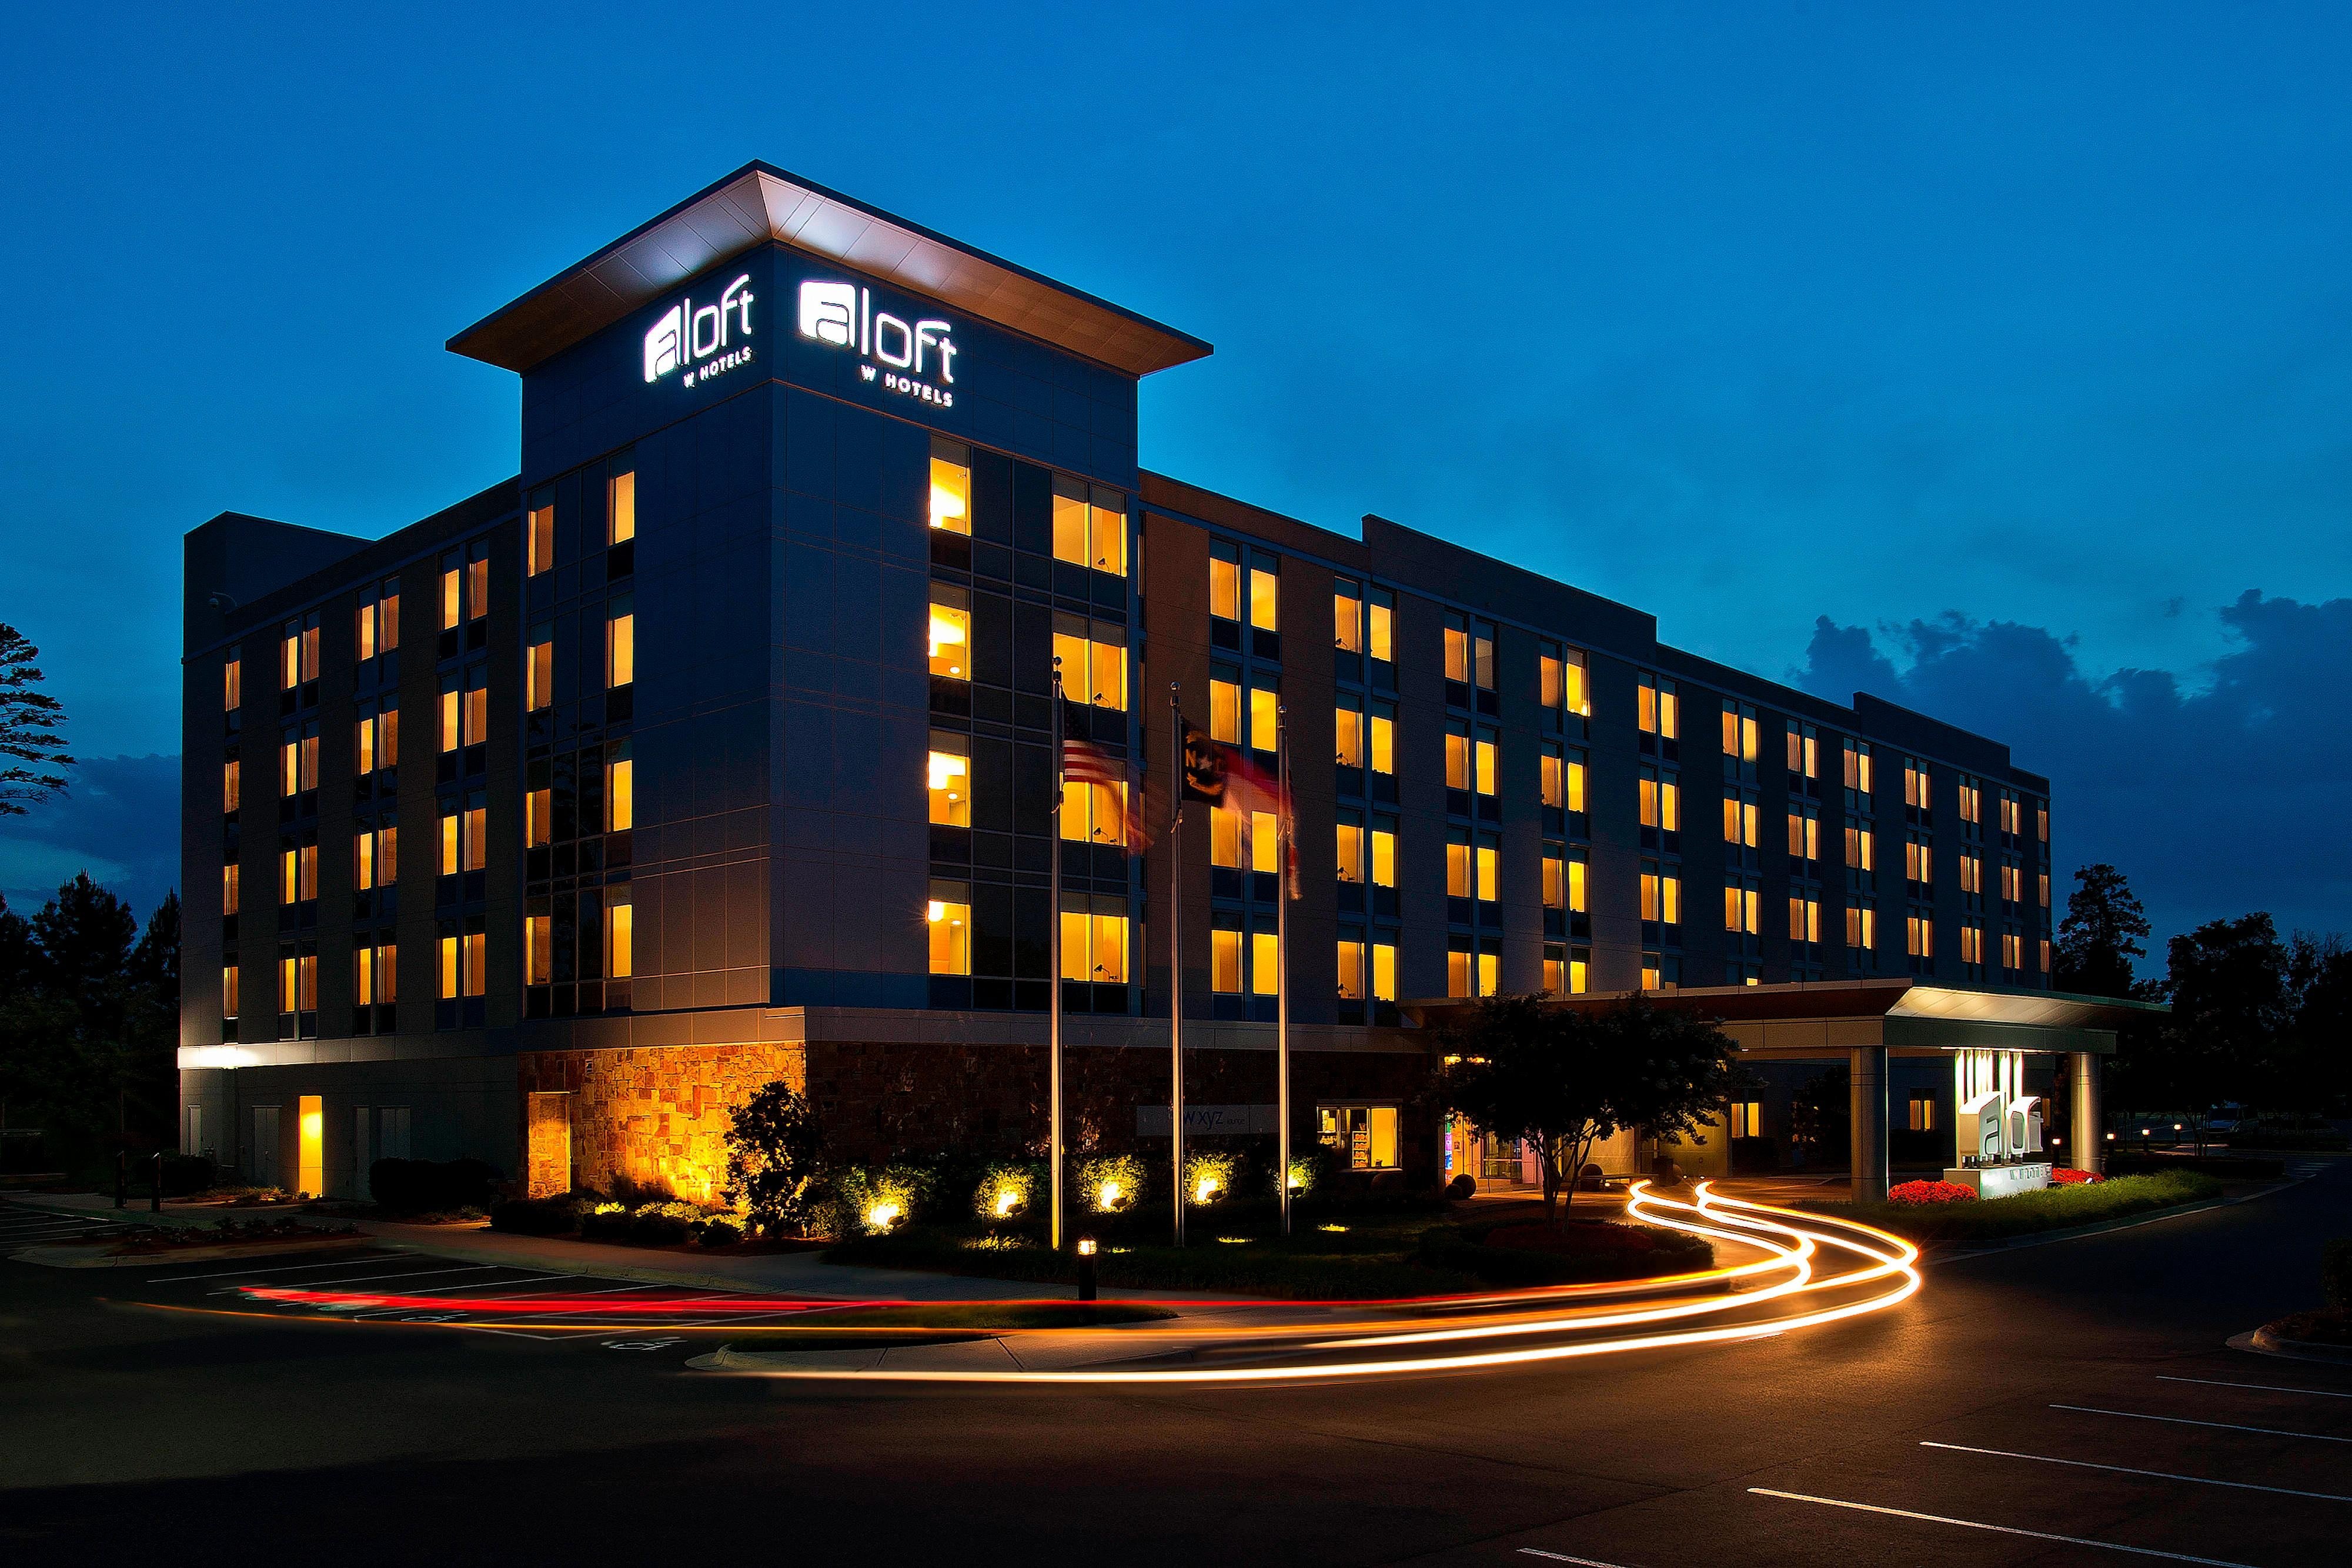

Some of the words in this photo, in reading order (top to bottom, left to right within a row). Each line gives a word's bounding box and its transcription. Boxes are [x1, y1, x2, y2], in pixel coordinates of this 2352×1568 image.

[683, 372, 696, 388] W
[699, 346, 752, 381] HOTELS
[860, 364, 877, 382] W
[884, 372, 954, 407] HOTELS
